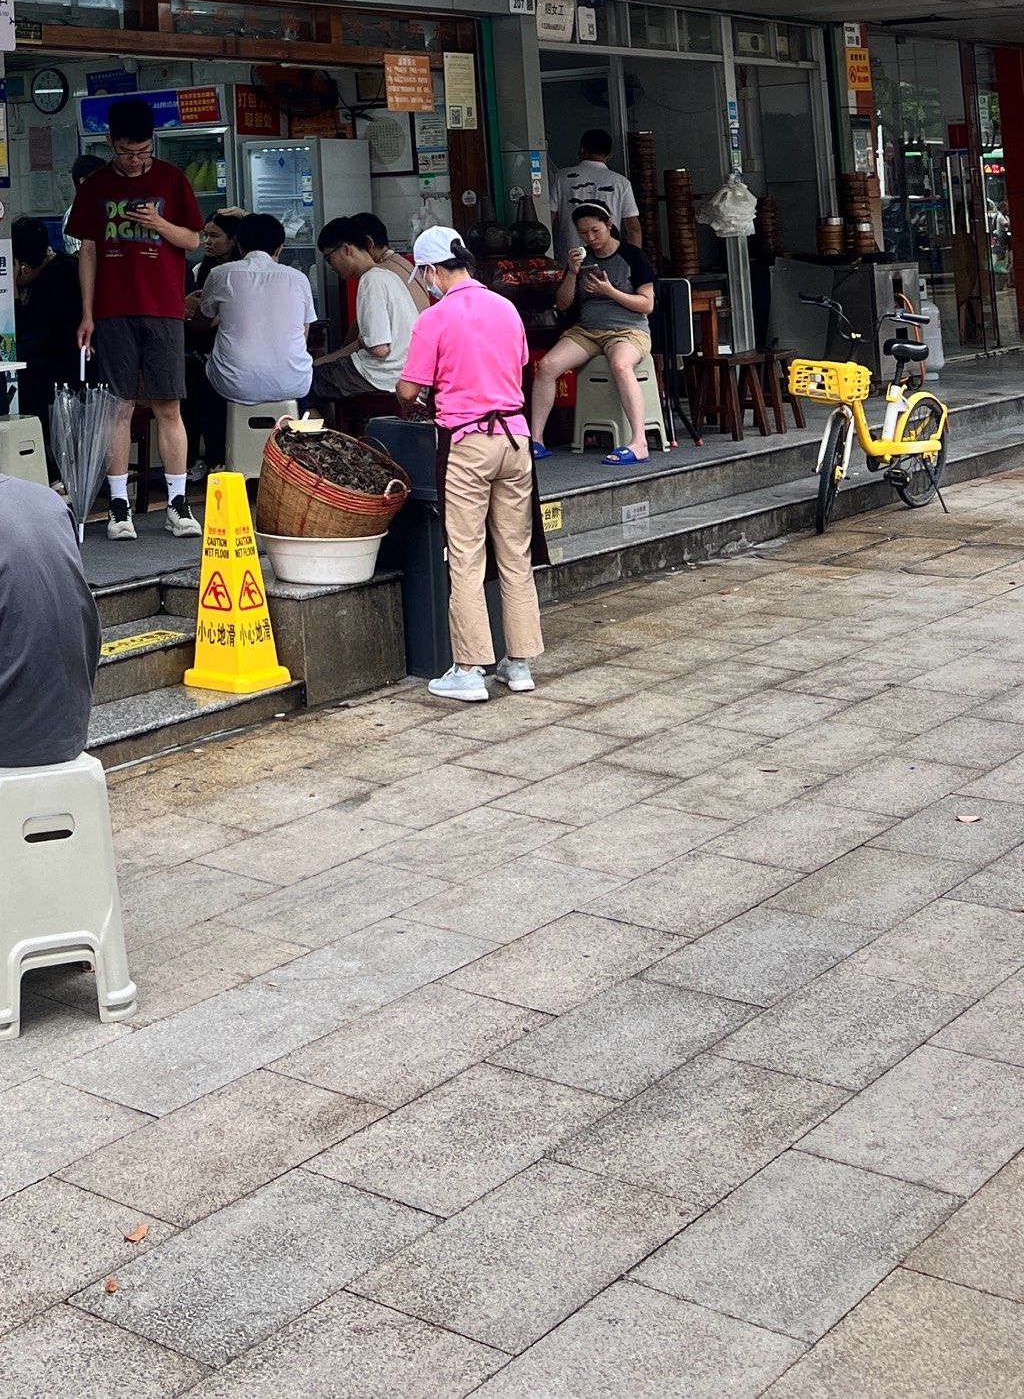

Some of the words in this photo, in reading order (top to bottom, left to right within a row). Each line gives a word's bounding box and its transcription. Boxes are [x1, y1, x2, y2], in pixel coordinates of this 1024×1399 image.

[243, 111, 273, 129] 取餐处
[206, 535, 228, 548] CAUTION
[235, 535, 253, 548] CAUTION
[204, 547, 214, 558] WET
[215, 548, 230, 560] FLOOR
[234, 548, 243, 559] WET
[243, 546, 256, 558] FLOOR
[197, 619, 236, 647] 小心地滑
[239, 617, 272, 647] 小心地滑
